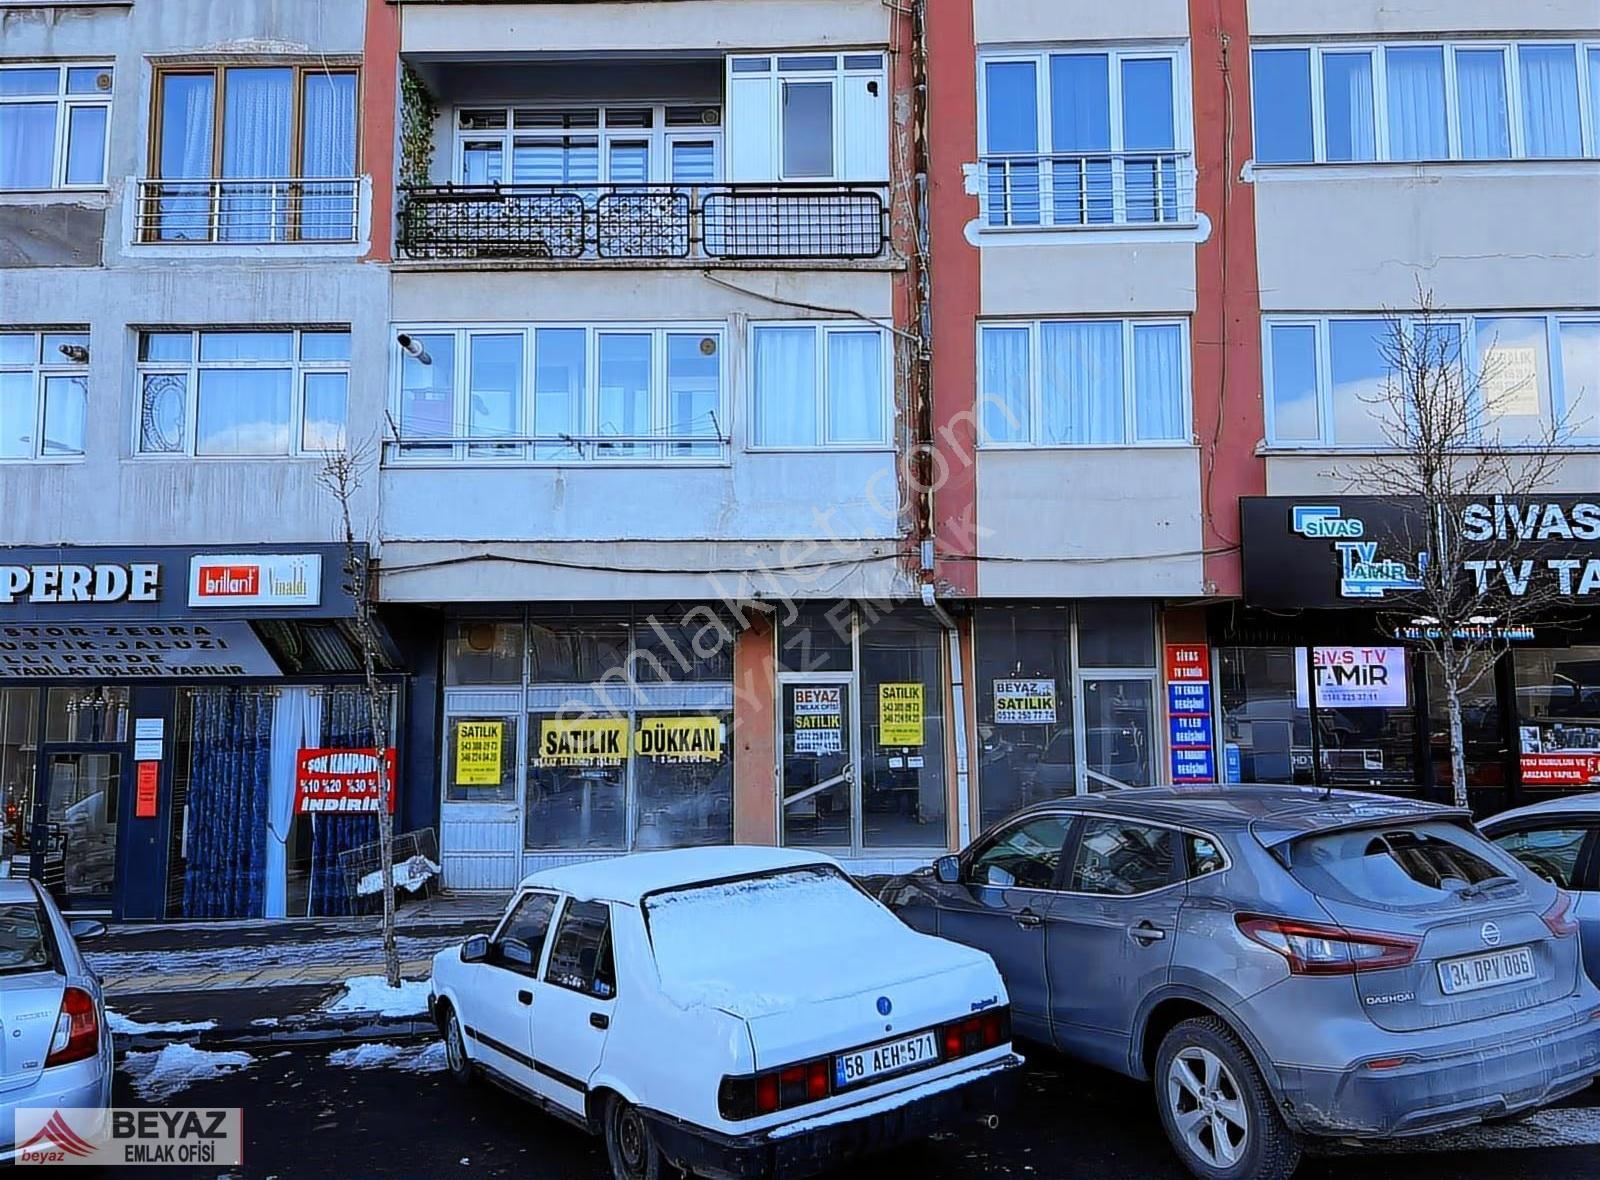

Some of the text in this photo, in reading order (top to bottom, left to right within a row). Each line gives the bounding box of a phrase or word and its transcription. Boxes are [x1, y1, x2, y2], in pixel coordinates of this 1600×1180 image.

[1463, 494, 1600, 541] SİVAS
[1305, 518, 1362, 536] SİVAS
[0, 564, 161, 602] PERDE
[205, 568, 255, 594] brillant
[1464, 559, 1600, 595] TV TA
[62, 654, 164, 664] PERDE
[1361, 650, 1386, 663] TV
[98, 665, 162, 678] İŞLERİ
[165, 665, 247, 676] YAPILIR
[882, 687, 920, 699] SATILIK
[997, 683, 1038, 693] BEYAZ
[795, 690, 839, 703] BEYAZ
[997, 697, 1052, 710] SATILIK
[795, 715, 840, 729] SATILIK
[461, 726, 498, 738] SATILIK
[641, 723, 716, 753] DÜKKAN
[545, 729, 620, 756] SATILIK
[307, 753, 385, 775] ŞOK KAMPANY
[300, 779, 320, 793] %10
[322, 779, 342, 793] %20
[1451, 964, 1470, 986] 34
[1504, 952, 1529, 976] 086
[845, 1035, 933, 1079] 58 AEH 571
